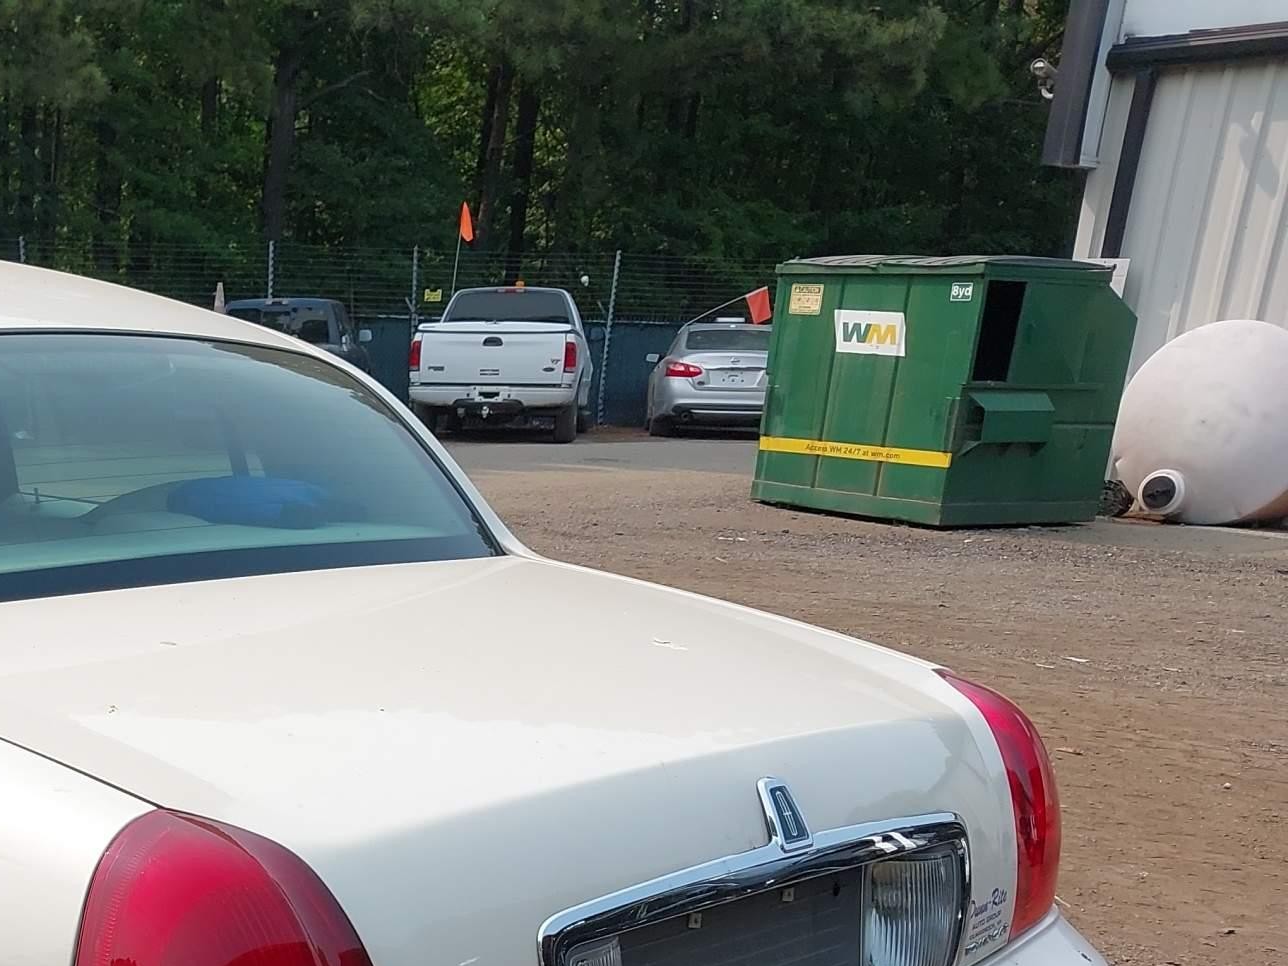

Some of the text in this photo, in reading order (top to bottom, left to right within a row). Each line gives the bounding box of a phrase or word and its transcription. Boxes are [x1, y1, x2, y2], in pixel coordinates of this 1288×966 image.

[952, 285, 972, 299] 8yd
[842, 321, 897, 345] WM
[843, 447, 861, 456] 24/7
